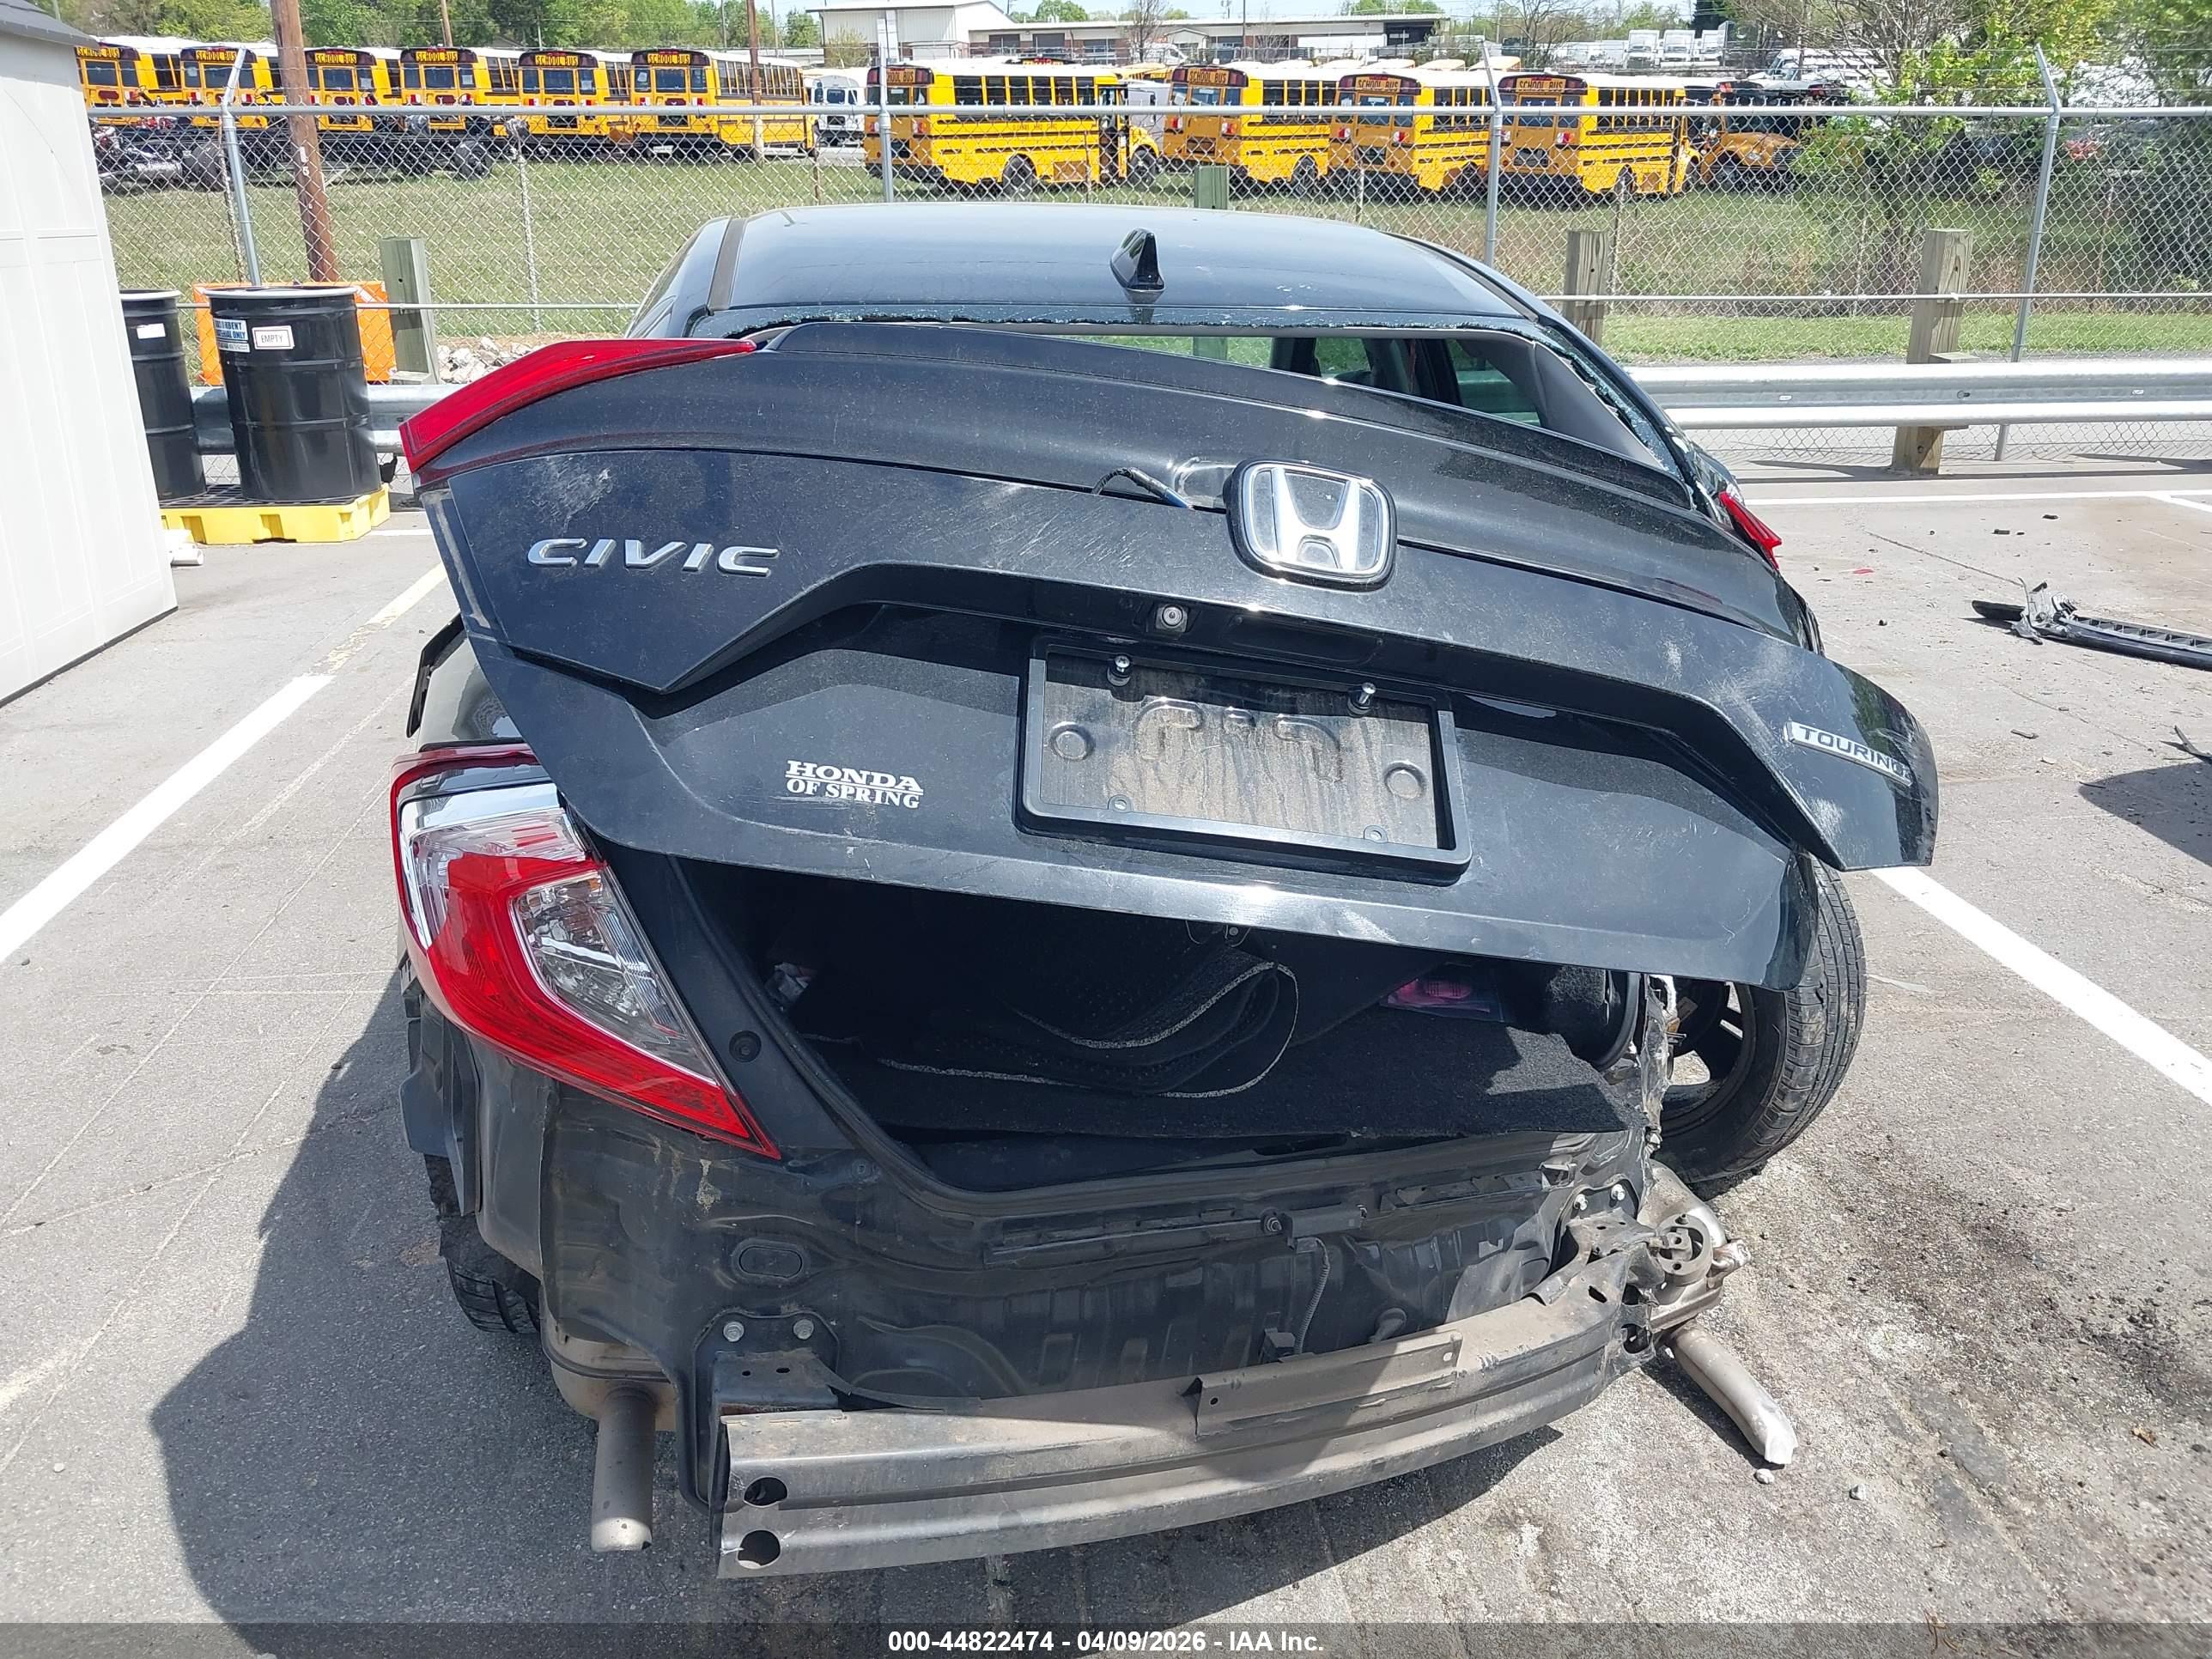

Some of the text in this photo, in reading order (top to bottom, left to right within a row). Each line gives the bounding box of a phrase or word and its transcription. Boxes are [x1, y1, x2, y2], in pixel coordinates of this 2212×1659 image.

[197, 51, 236, 61] SCHOOL BUS
[316, 54, 356, 64] SCHOOL BUS
[417, 52, 458, 62] SCHOOL BUS
[536, 56, 578, 65] SCHOOL BUS
[648, 54, 690, 64] SCHOOL BUS
[887, 71, 914, 82] HOOL BUS
[1189, 70, 1227, 84] SCHOOL BUS
[1358, 79, 1399, 92] SCHOOL BUS
[1519, 81, 1563, 92] SCHOOL BUS
[260, 334, 283, 343] EMPTY
[527, 538, 780, 577] CIVIC
[1798, 725, 1909, 775] TOURING
[785, 760, 923, 791] HONDA
[786, 778, 921, 809] OF SPRING
